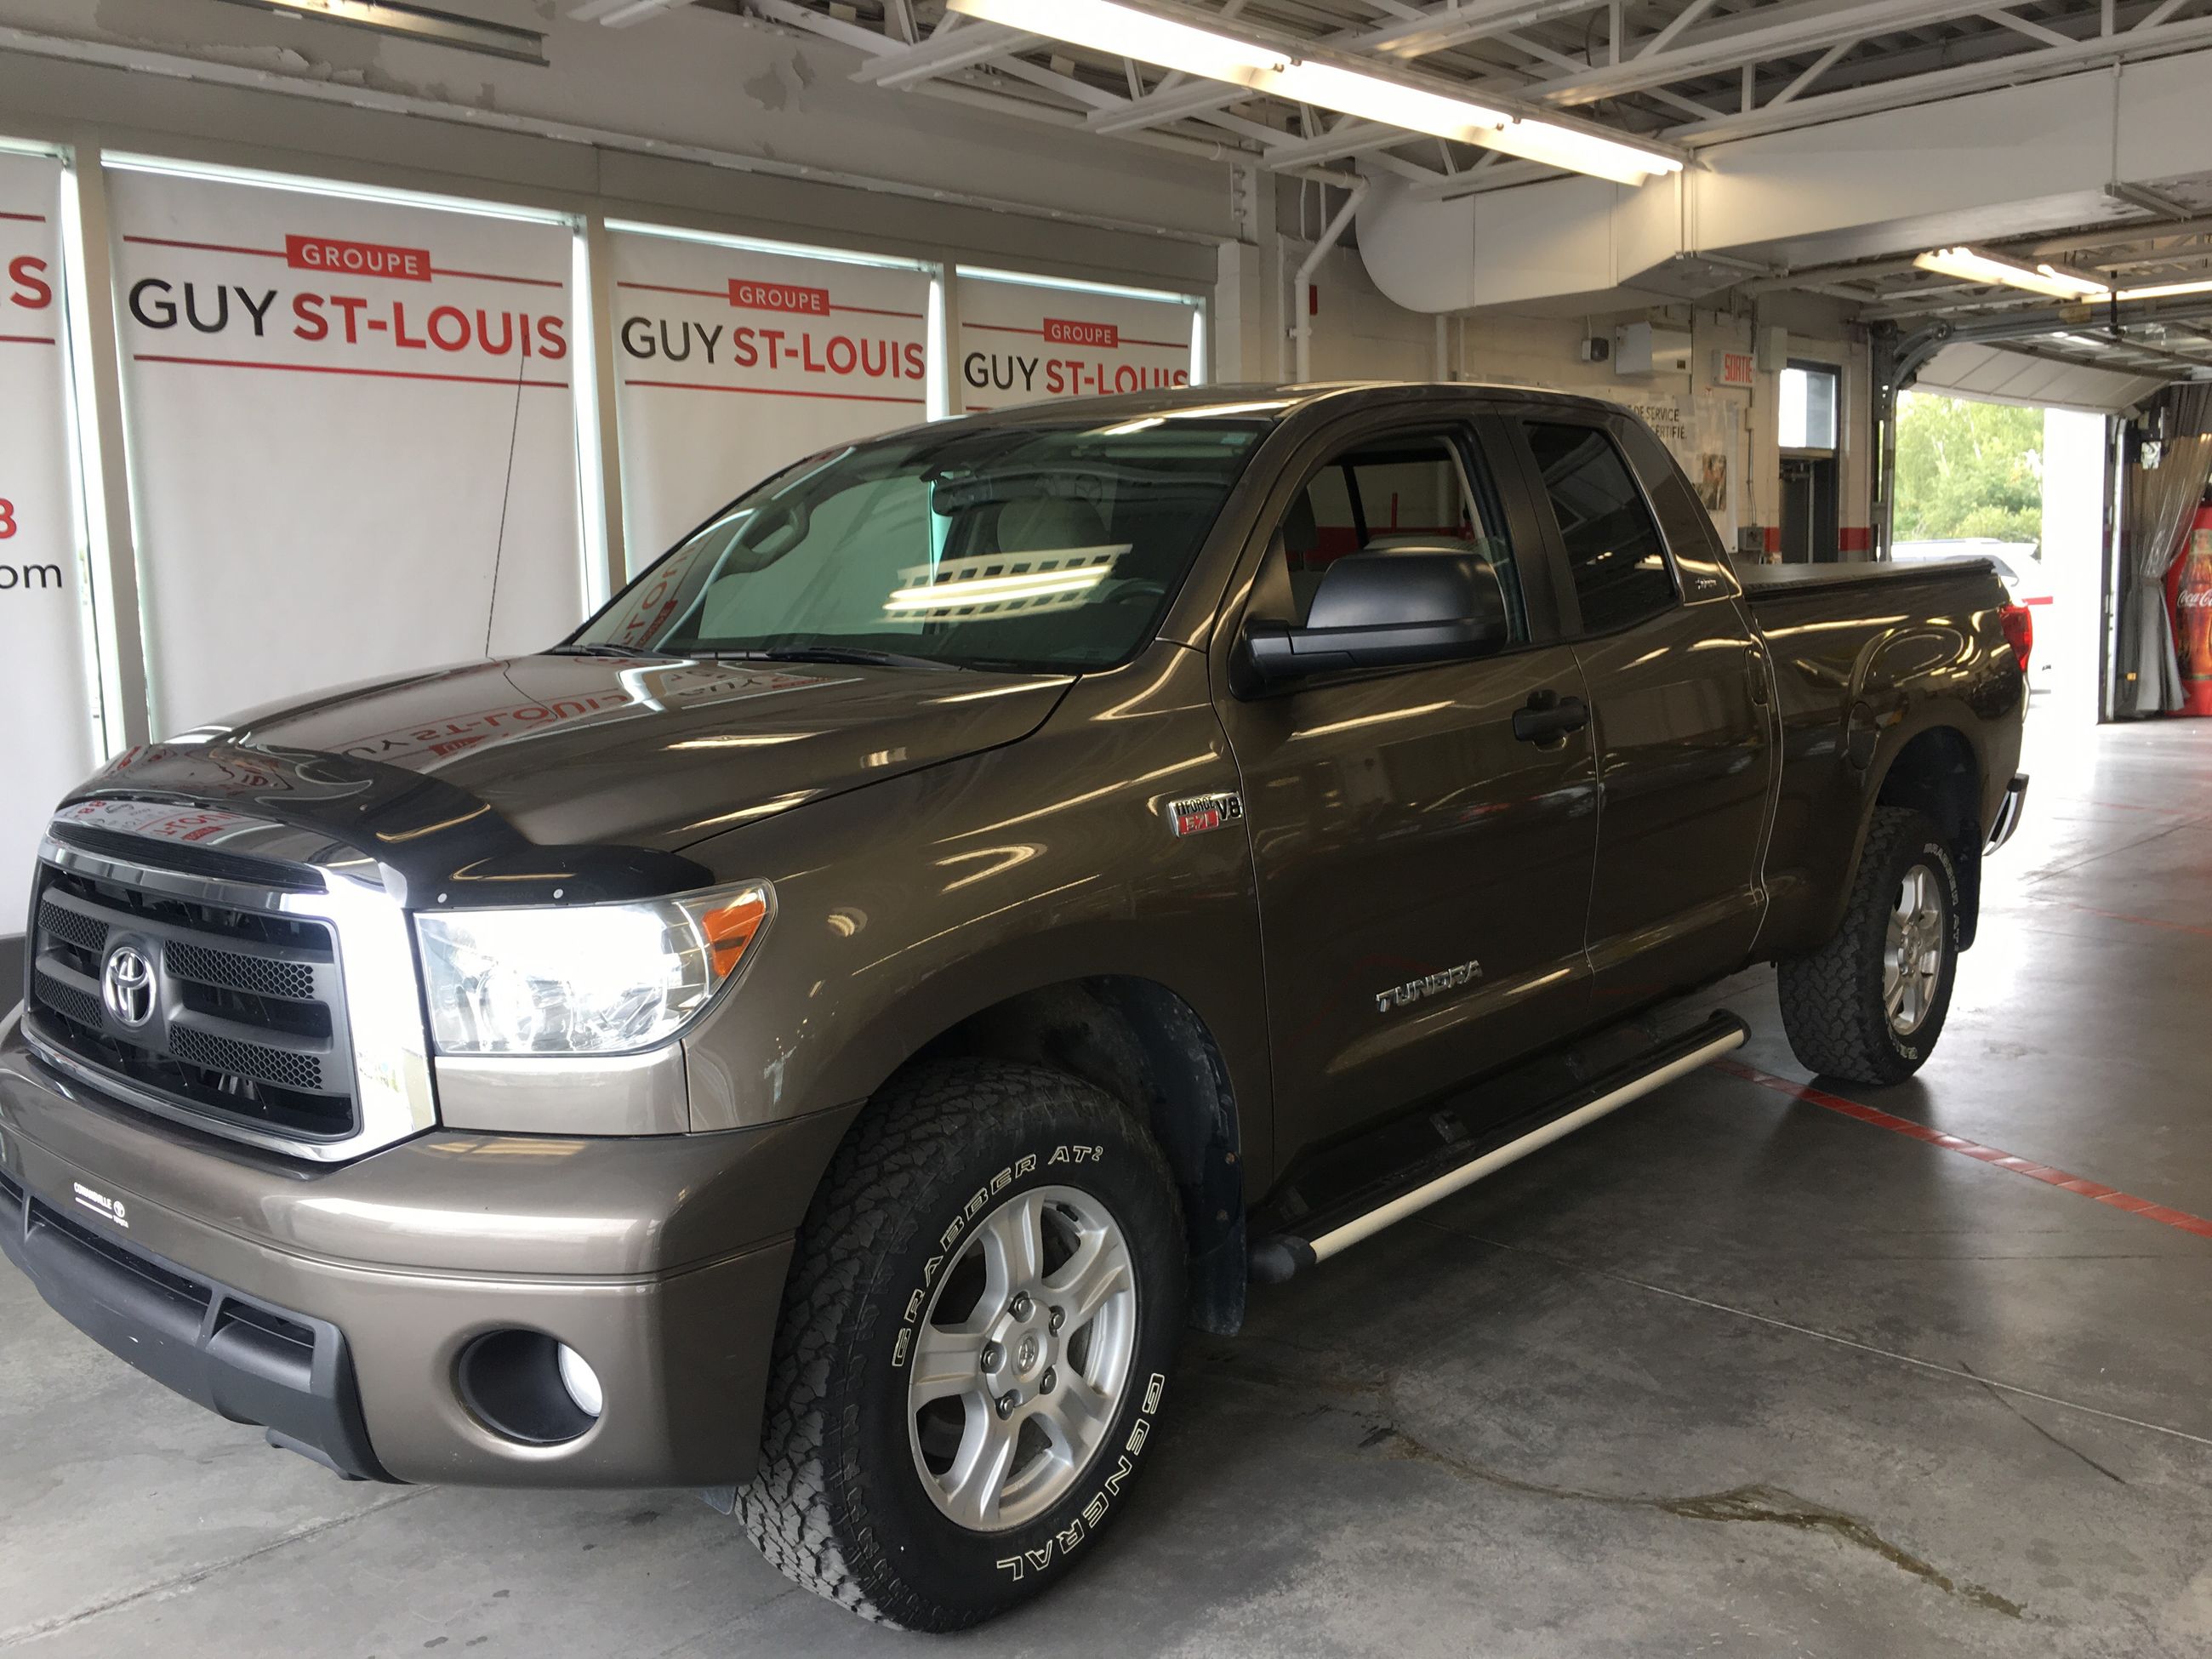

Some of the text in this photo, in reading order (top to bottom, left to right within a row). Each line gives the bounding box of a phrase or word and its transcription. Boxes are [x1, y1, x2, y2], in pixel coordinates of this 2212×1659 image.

[302, 244, 419, 275] GROUPE
[738, 286, 821, 311] GROUPE
[129, 278, 566, 359] GUY ST-LOUIS
[1051, 324, 1112, 344] GROUPE
[620, 316, 925, 380] GUY ST-LOUIS
[964, 351, 1039, 391] GUY
[1725, 354, 1753, 383] SORTIE
[1646, 406, 1679, 422] SERVICE
[1214, 795, 1242, 821] V8
[1375, 960, 1483, 1013] TUNDRA
[892, 1154, 1036, 1366] GRABBER
[996, 1372, 1165, 1582] GENERAL
